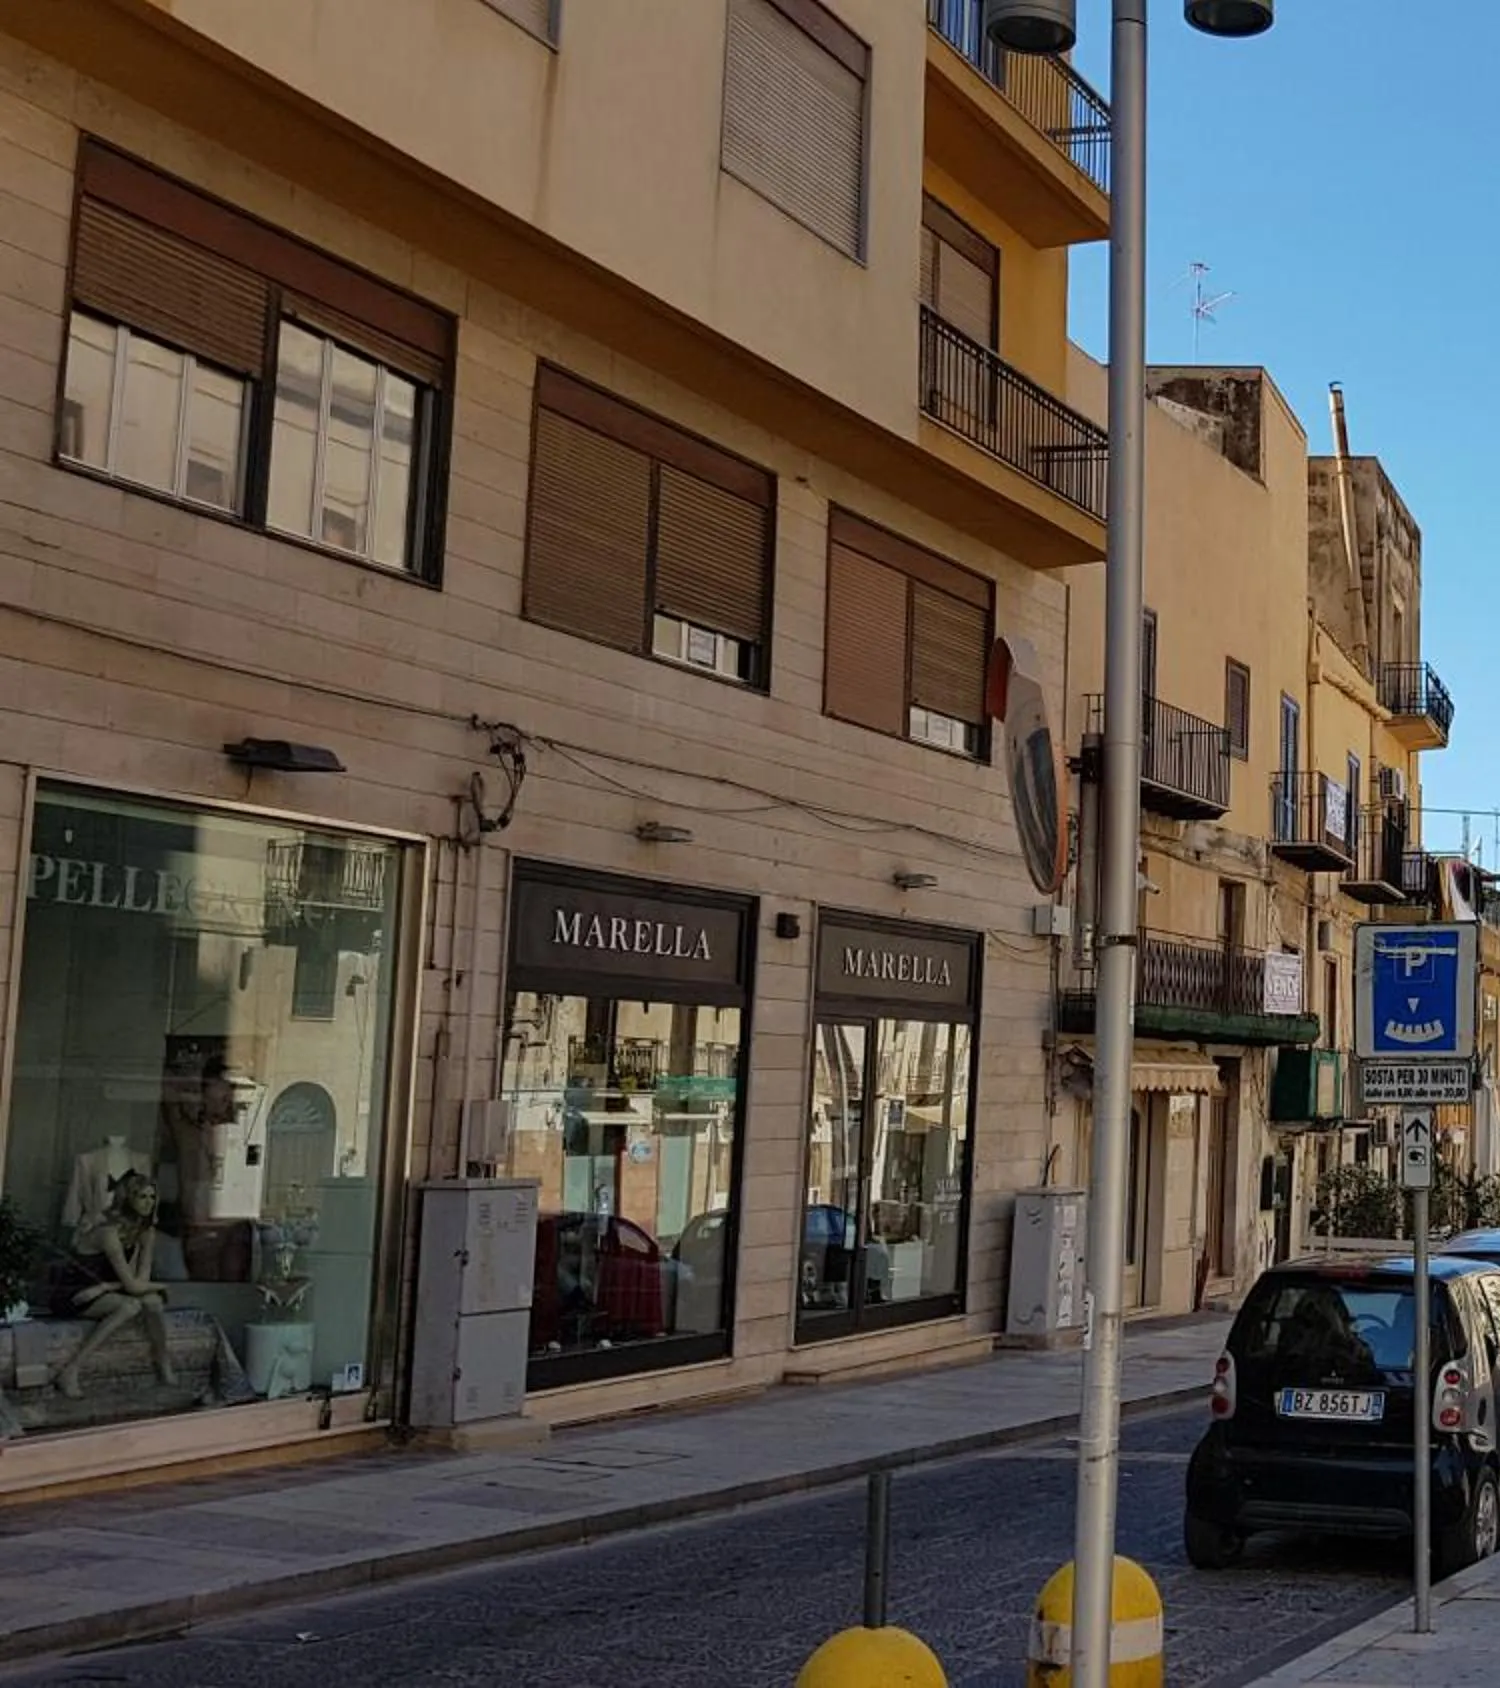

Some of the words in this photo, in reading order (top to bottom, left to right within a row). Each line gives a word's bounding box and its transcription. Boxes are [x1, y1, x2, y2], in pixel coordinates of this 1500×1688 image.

[553, 909, 712, 961] MARELLA
[843, 946, 951, 987] MARELLA
[1365, 1068, 1395, 1085] SOSTA
[1397, 1068, 1415, 1085] PER
[1417, 1068, 1429, 1084] 30
[1431, 1068, 1466, 1084] MINUTI
